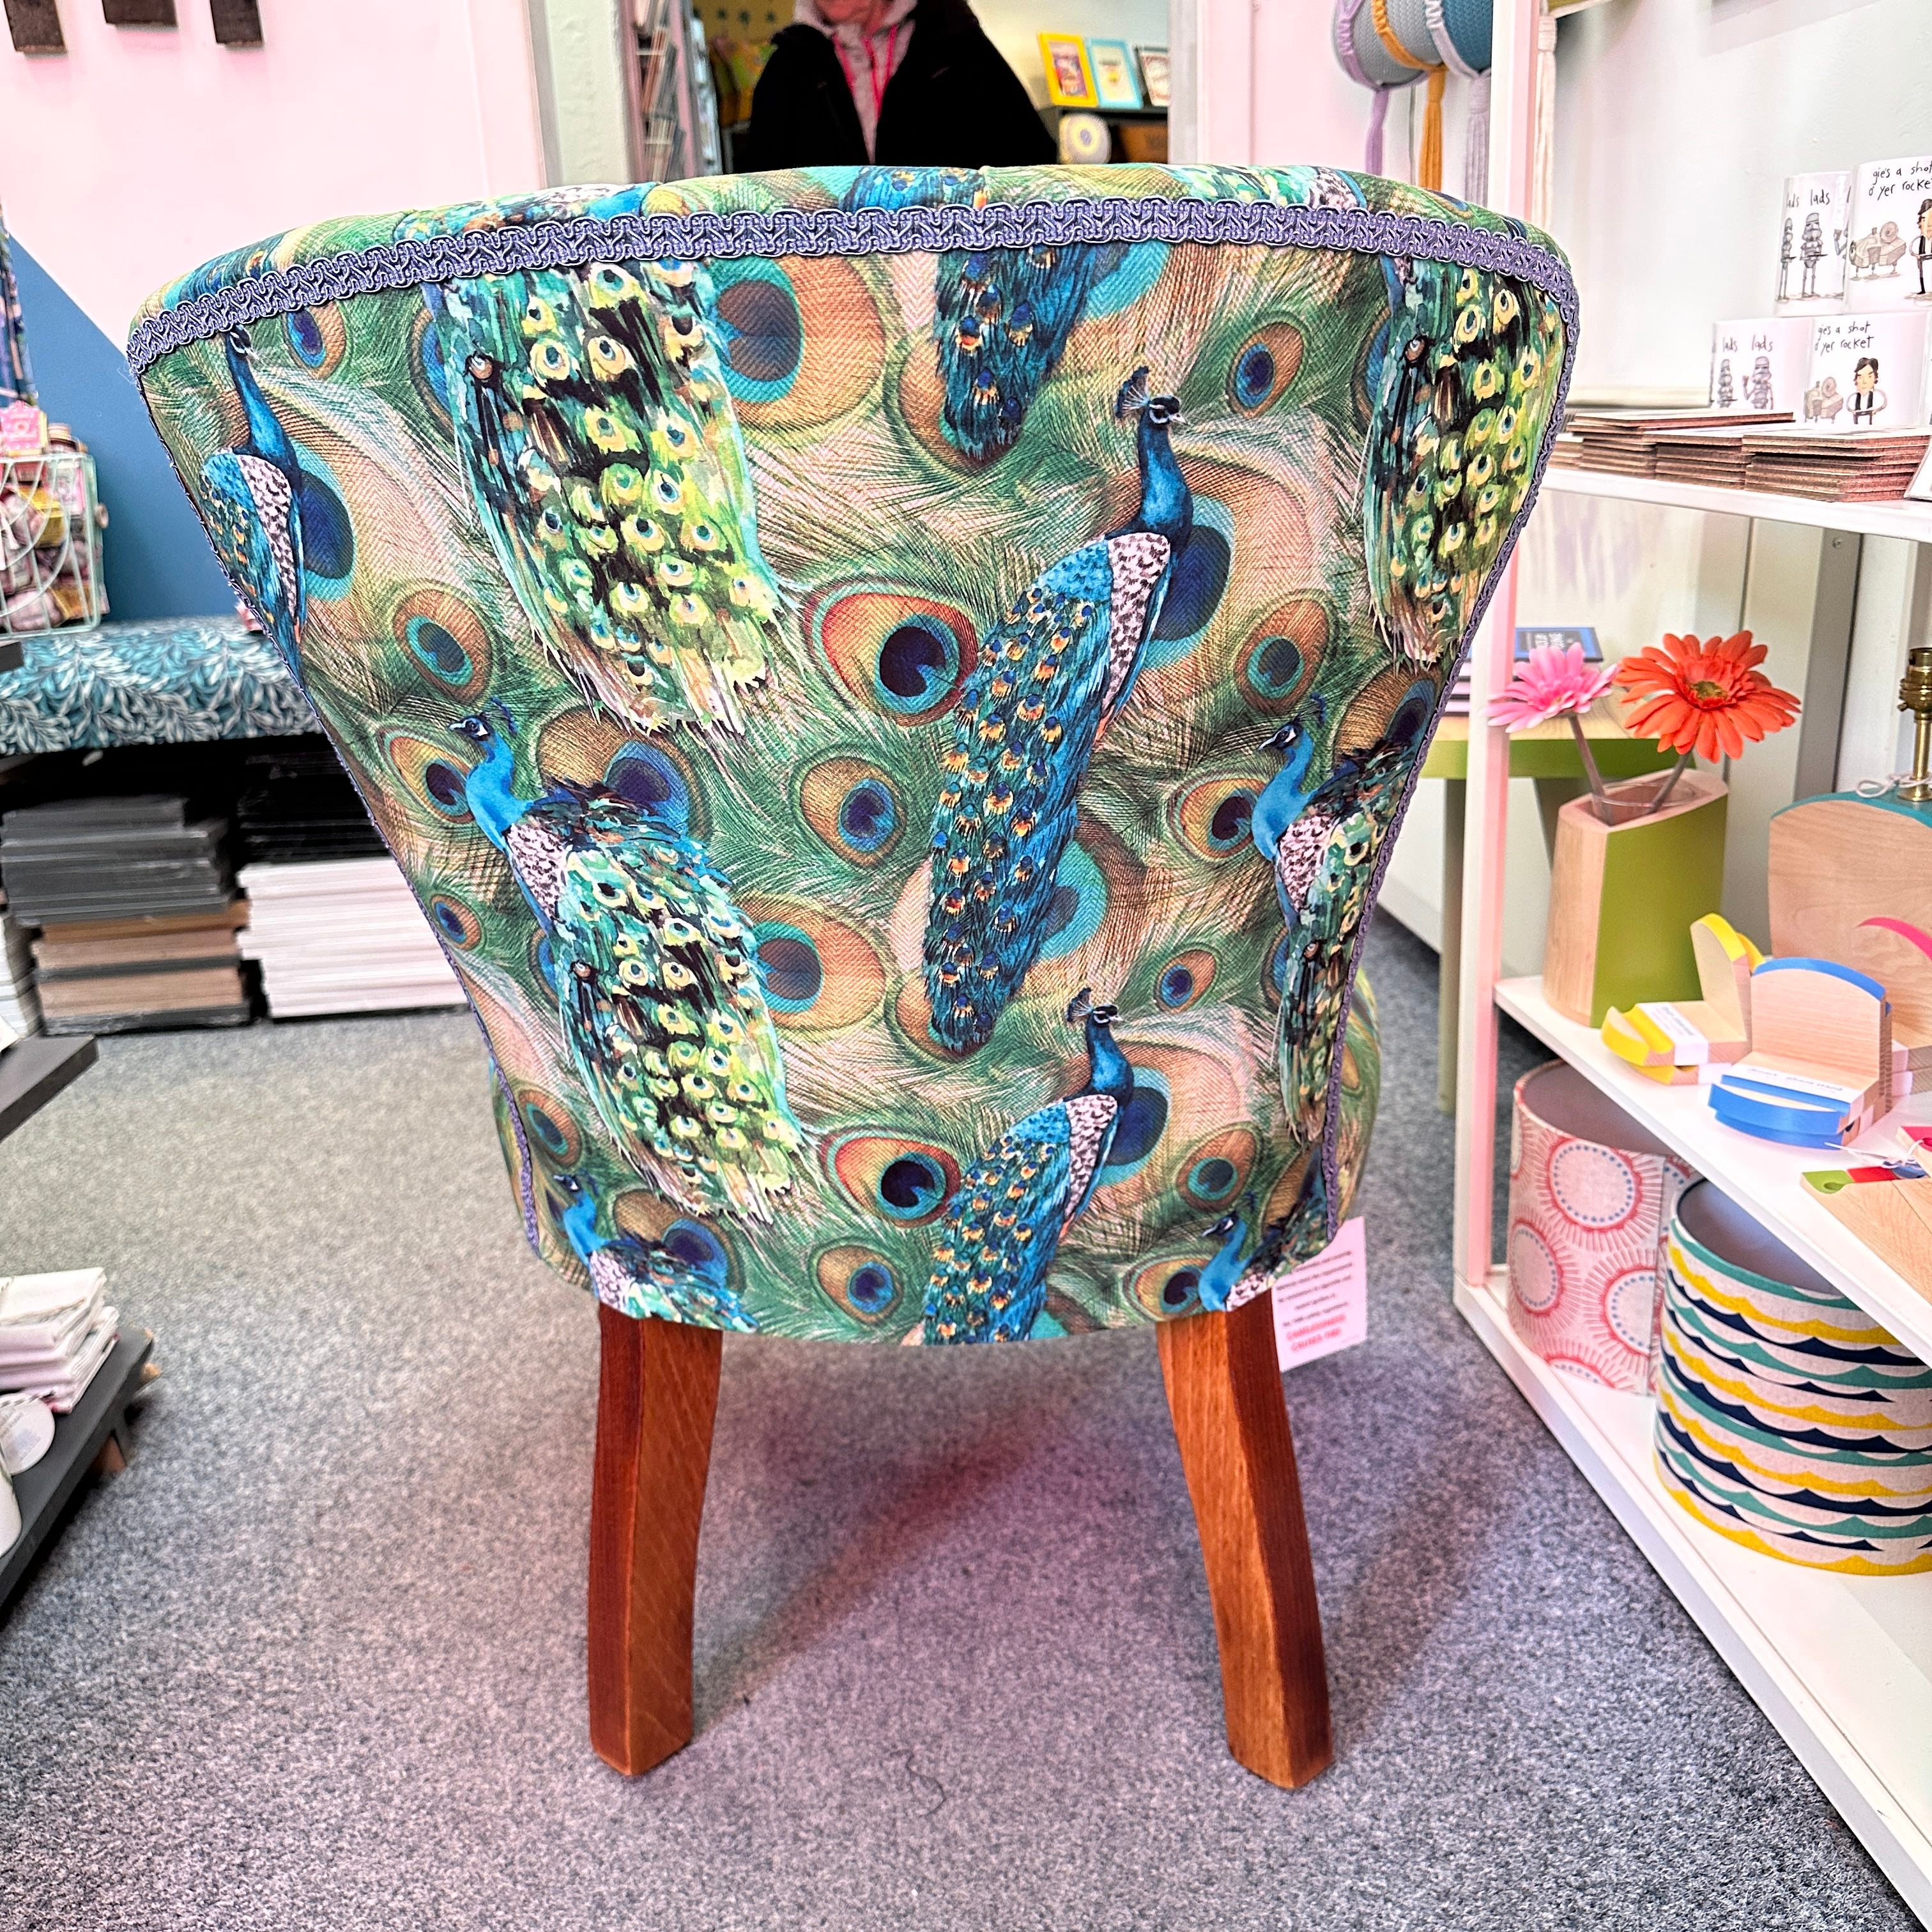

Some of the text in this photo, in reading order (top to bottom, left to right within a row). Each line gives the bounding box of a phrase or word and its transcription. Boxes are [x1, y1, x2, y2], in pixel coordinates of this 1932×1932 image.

[1896, 167, 1902, 176] a
[1810, 188, 1830, 206] lads
[1877, 183, 1896, 201] yer
[1902, 178, 1932, 191] rocke
[1848, 321, 1871, 334] shot
[1751, 334, 1774, 353] lads
[1820, 341, 1836, 356] yer
[1840, 335, 1874, 349] rocket
